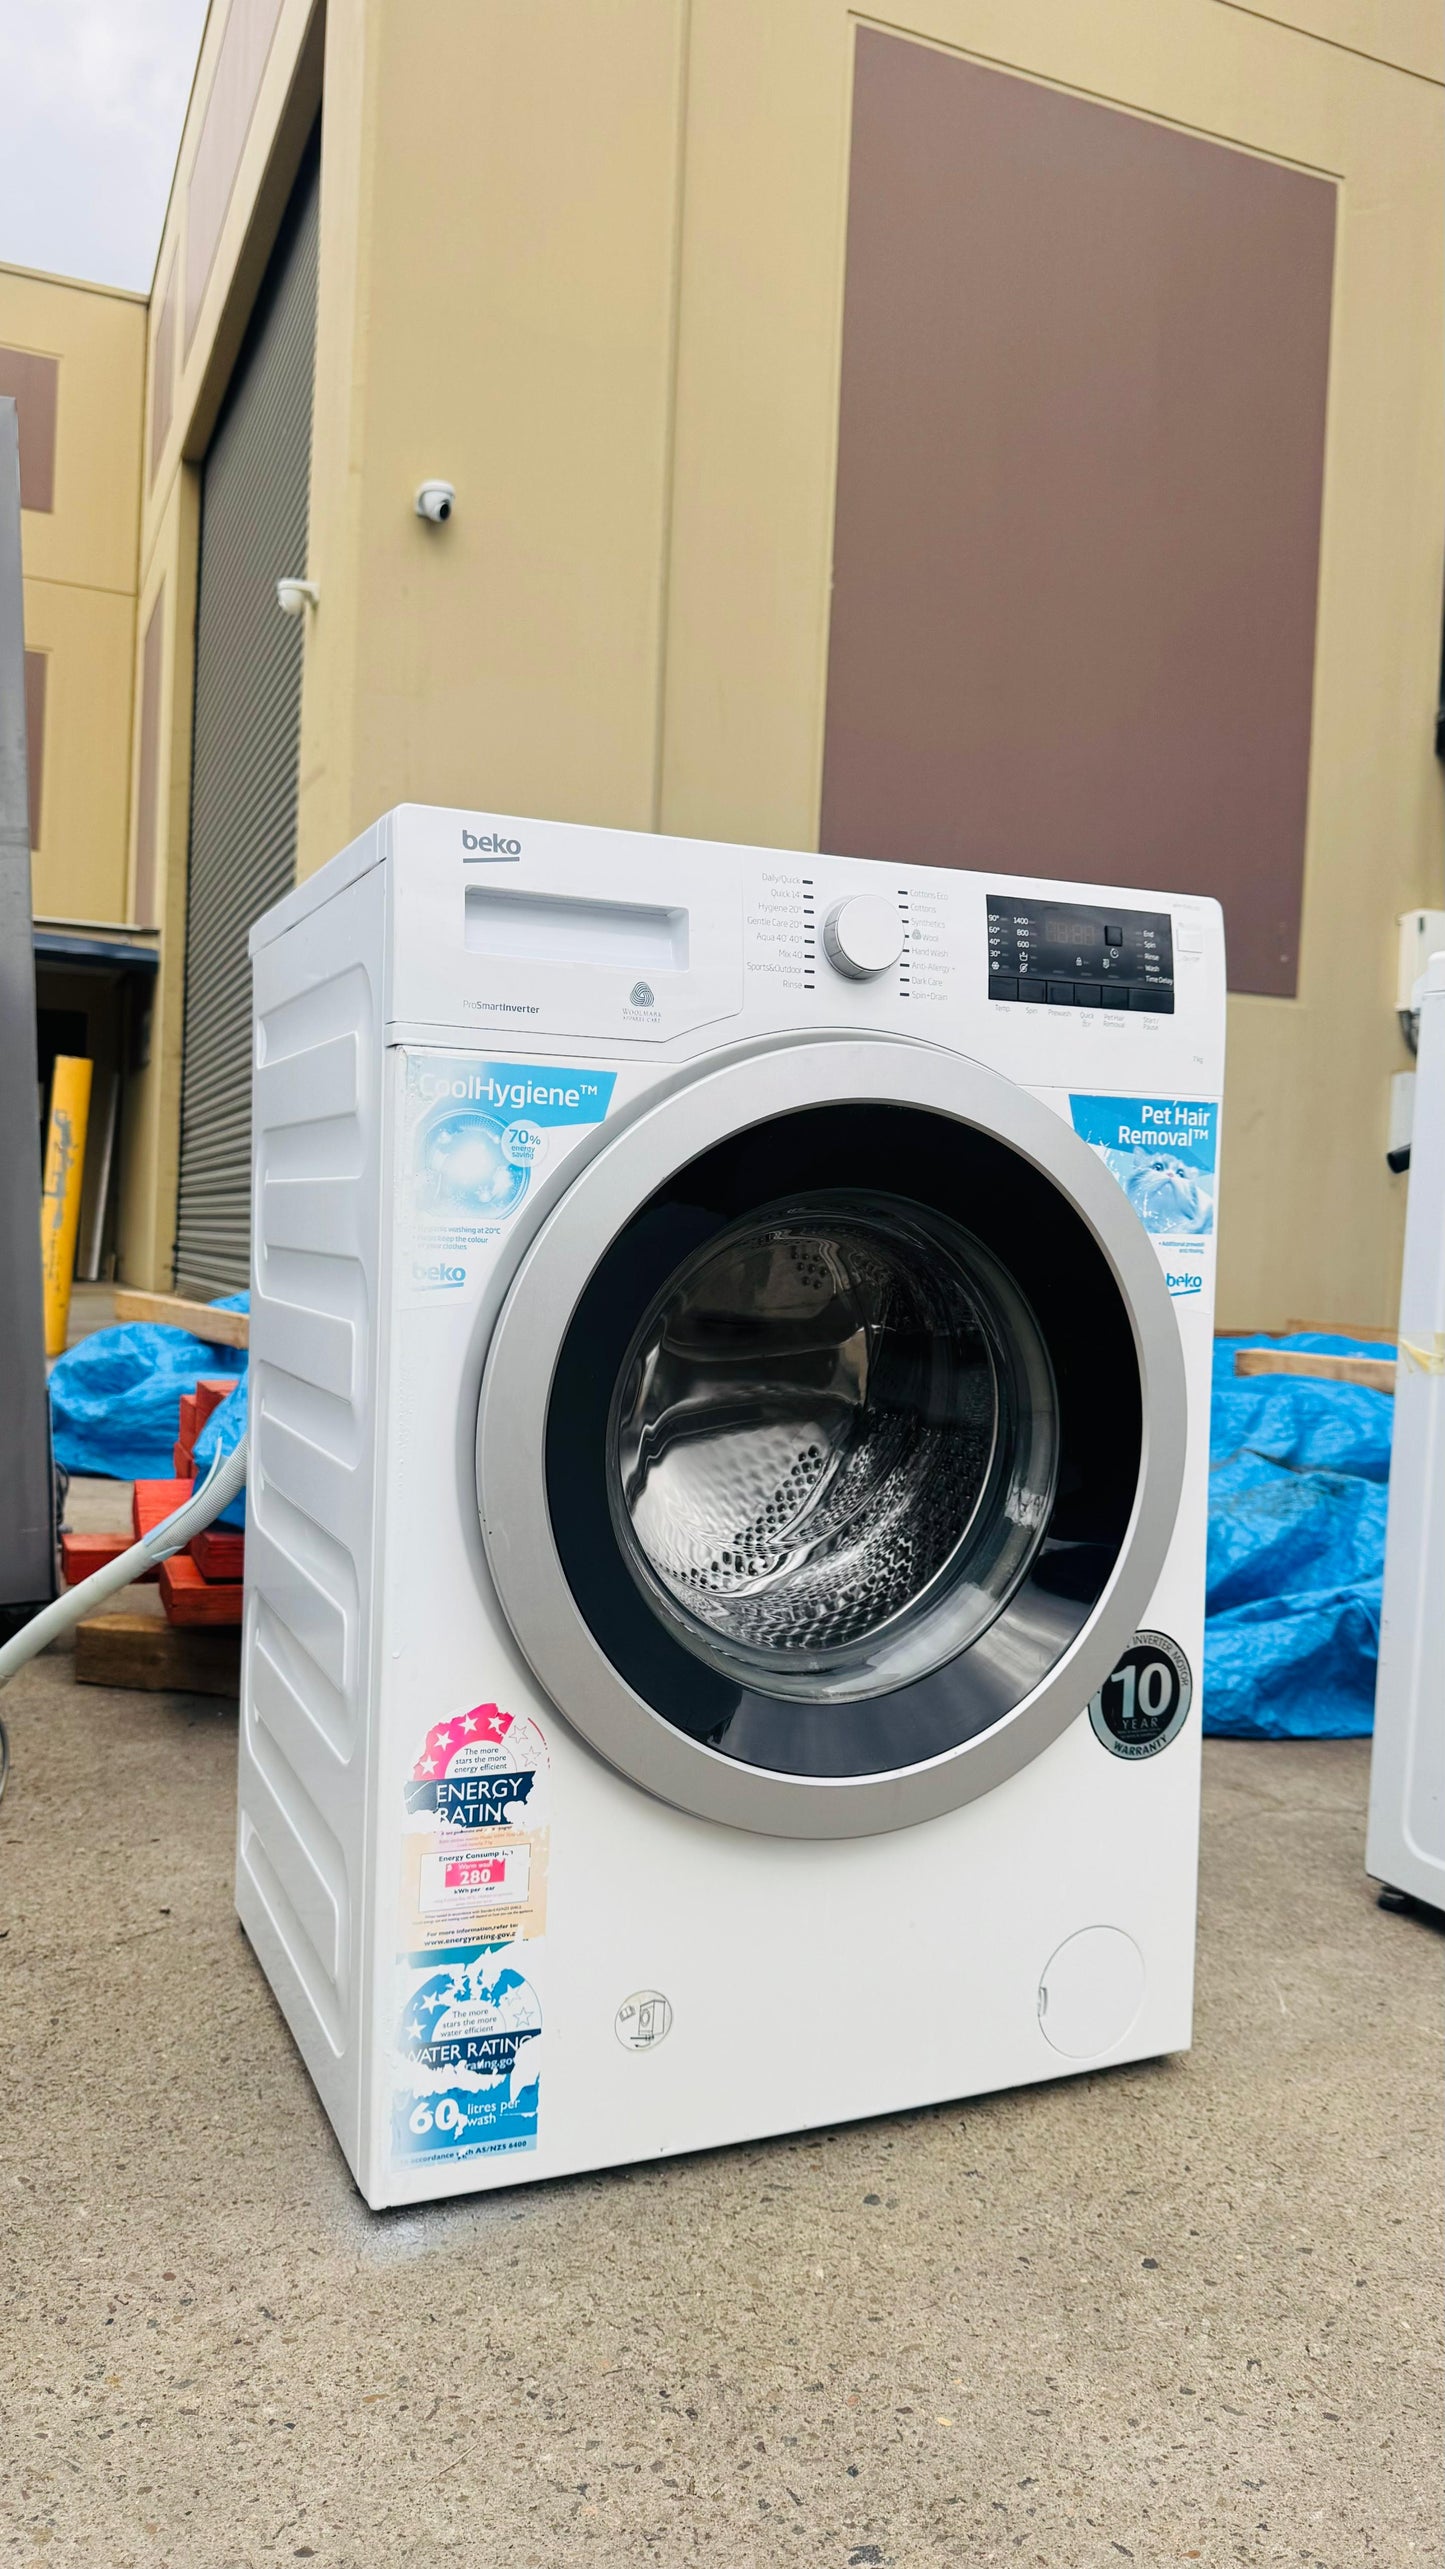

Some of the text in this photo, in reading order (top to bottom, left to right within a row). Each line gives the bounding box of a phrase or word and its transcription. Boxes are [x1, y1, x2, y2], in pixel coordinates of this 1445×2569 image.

[462, 829, 521, 855] beko
[761, 872, 801, 884] Daily/Quick
[771, 889, 790, 899] Quick
[910, 889, 935, 899] Cottons
[758, 903, 787, 914] Hygiene
[910, 904, 936, 914] Cottons
[747, 916, 770, 926] Gentle
[771, 918, 788, 927] Care
[911, 917, 945, 929] Synthetics
[1013, 916, 1028, 925] 1400
[757, 932, 775, 943] Aqua
[922, 933, 938, 942] Wool
[1017, 929, 1029, 937] 800
[1143, 930, 1154, 938] End
[1017, 940, 1029, 948] 600
[1144, 941, 1156, 949] Spin
[779, 949, 803, 959] Mix 40
[912, 947, 948, 957] Hand Wash
[1144, 952, 1159, 961] Rinse
[747, 962, 802, 974] Sports&Outdoor
[1145, 964, 1160, 973] Wash
[783, 980, 802, 989] Rinse
[912, 976, 943, 987] Dark Care
[1146, 975, 1173, 986] Time Delay
[462, 999, 540, 1014] ProSmartInverter
[622, 1007, 662, 1018] WOOLMARK
[1141, 1105, 1210, 1127] Pet Hair
[508, 1128, 541, 1145] 70%
[511, 1145, 535, 1154] energy
[511, 1151, 534, 1160] saving
[448, 1225, 476, 1234] washing
[467, 1236, 489, 1244] colour
[442, 1243, 467, 1251] clothes
[413, 1262, 467, 1282] beko
[1166, 1272, 1202, 1288] beko
[1132, 1634, 1173, 1652] INVERTER
[1172, 1651, 1189, 1687] MOTOR
[1111, 1662, 1173, 1718] 10
[1122, 1718, 1158, 1730] YEAR
[1113, 1734, 1168, 1756] WARRANTY
[464, 1747, 499, 1756] The more
[455, 1755, 507, 1766] stars the more
[454, 1763, 507, 1774] energy efficient
[437, 1778, 523, 1803] ENERGY
[438, 1853, 464, 1863] Energy
[460, 1869, 491, 1885] 280
[470, 1887, 480, 1895] per
[452, 2008, 489, 2018] The more
[443, 2020, 461, 2028] stars
[440, 2025, 494, 2037] water efficient
[409, 2099, 520, 2135] 60 litres per
[466, 2113, 497, 2127] wash
[475, 2142, 507, 2154] AS/NZS
[509, 2140, 527, 2149] 6400
